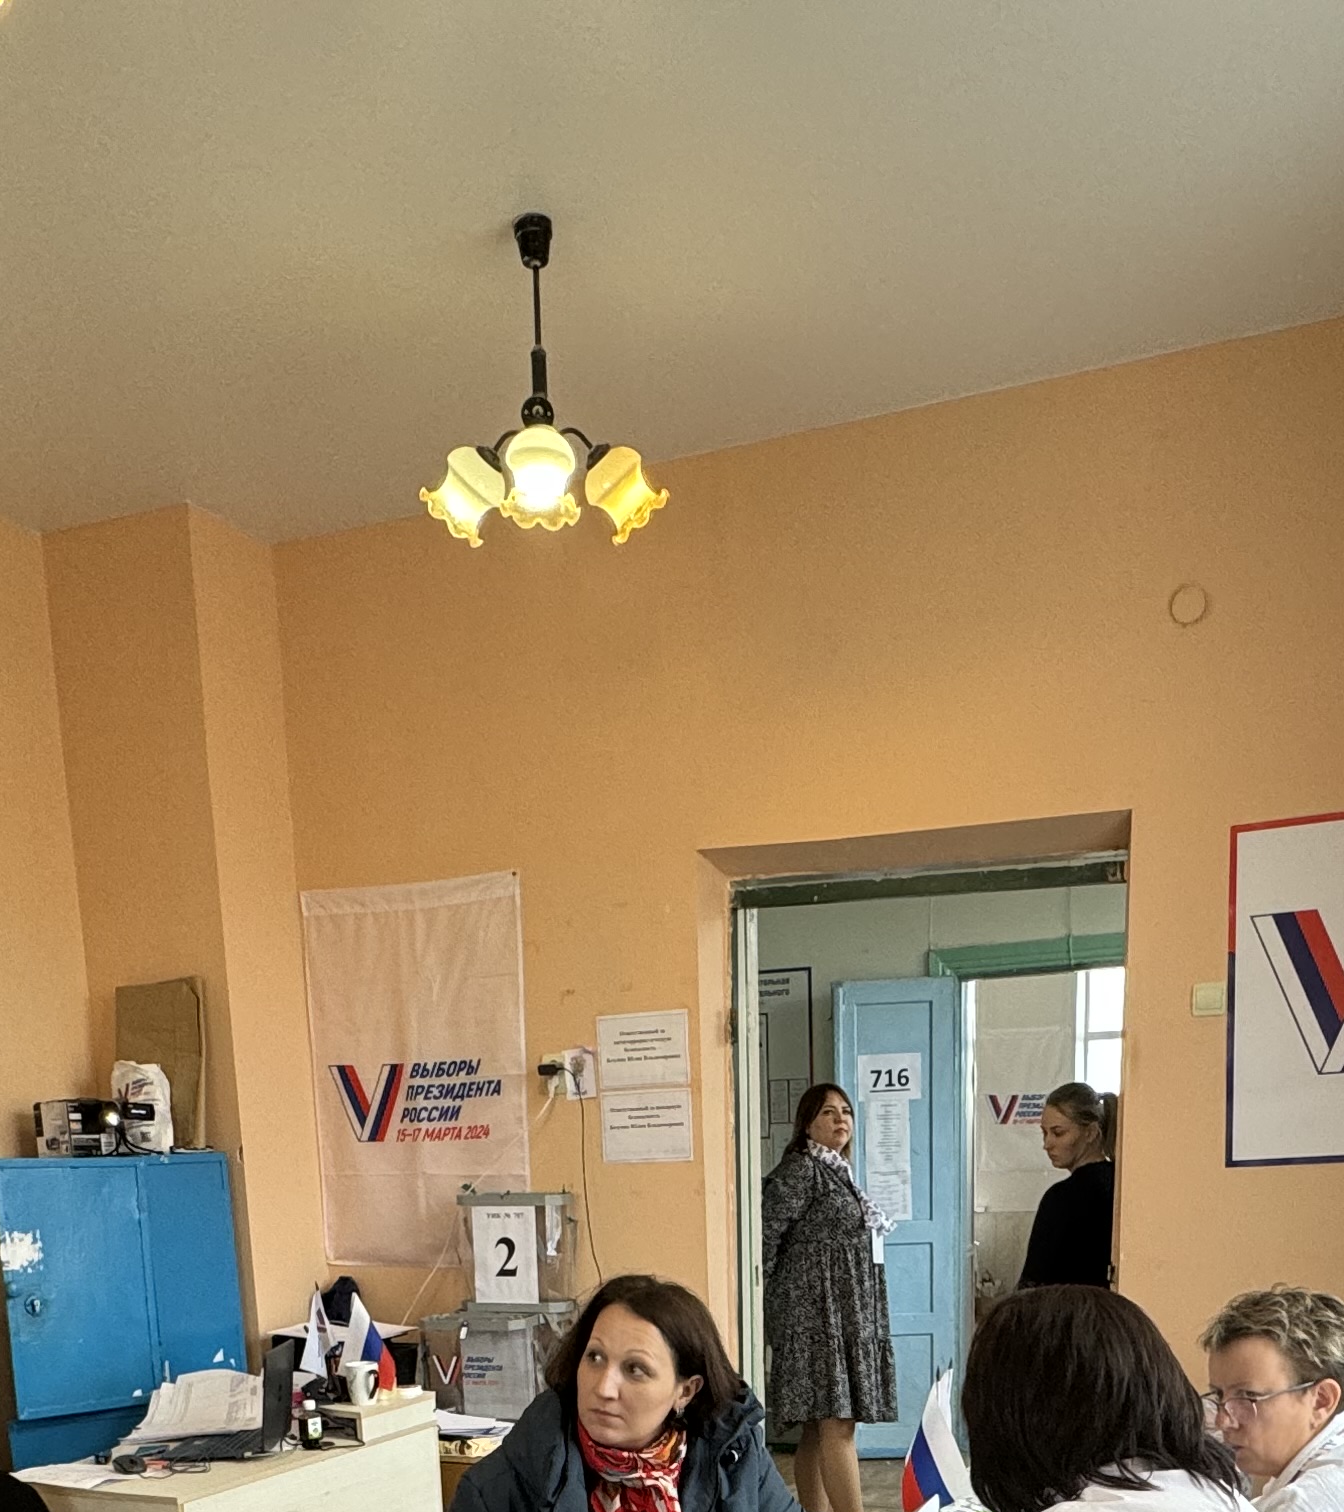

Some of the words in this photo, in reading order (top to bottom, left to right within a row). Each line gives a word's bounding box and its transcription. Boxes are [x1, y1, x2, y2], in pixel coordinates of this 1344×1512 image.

[409, 1059, 481, 1079] ВЫБОРЫ
[870, 1068, 910, 1088] 716
[406, 1079, 503, 1102] ПРЕЗИДЕНТА
[400, 1104, 461, 1124] РОССИИ
[422, 1125, 463, 1142] МАРТА
[463, 1125, 491, 1140] 2024
[494, 1236, 519, 1278] 2
